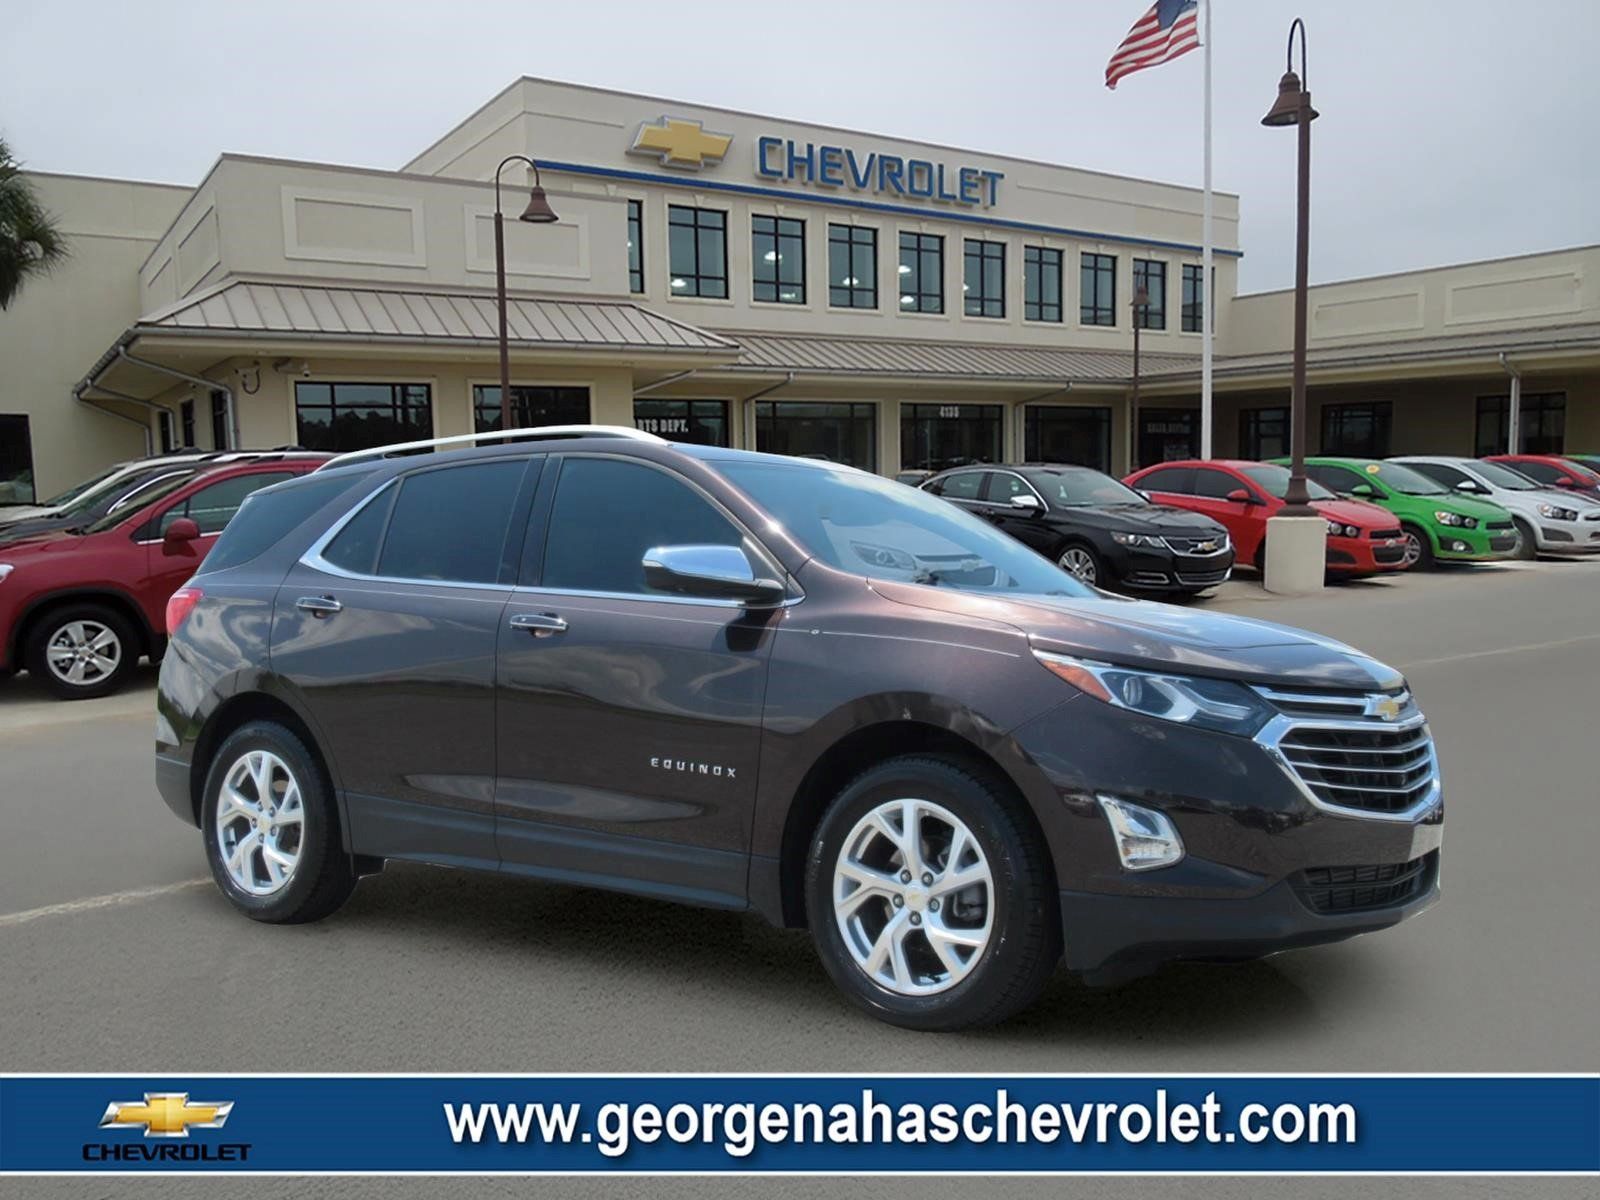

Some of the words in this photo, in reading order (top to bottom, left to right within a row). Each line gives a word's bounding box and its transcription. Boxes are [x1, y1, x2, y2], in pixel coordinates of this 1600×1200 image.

[757, 135, 1005, 208] CHEVROLET
[635, 419, 658, 432] RTS
[660, 419, 689, 433] DEPT.
[650, 757, 736, 778] EQUINOX
